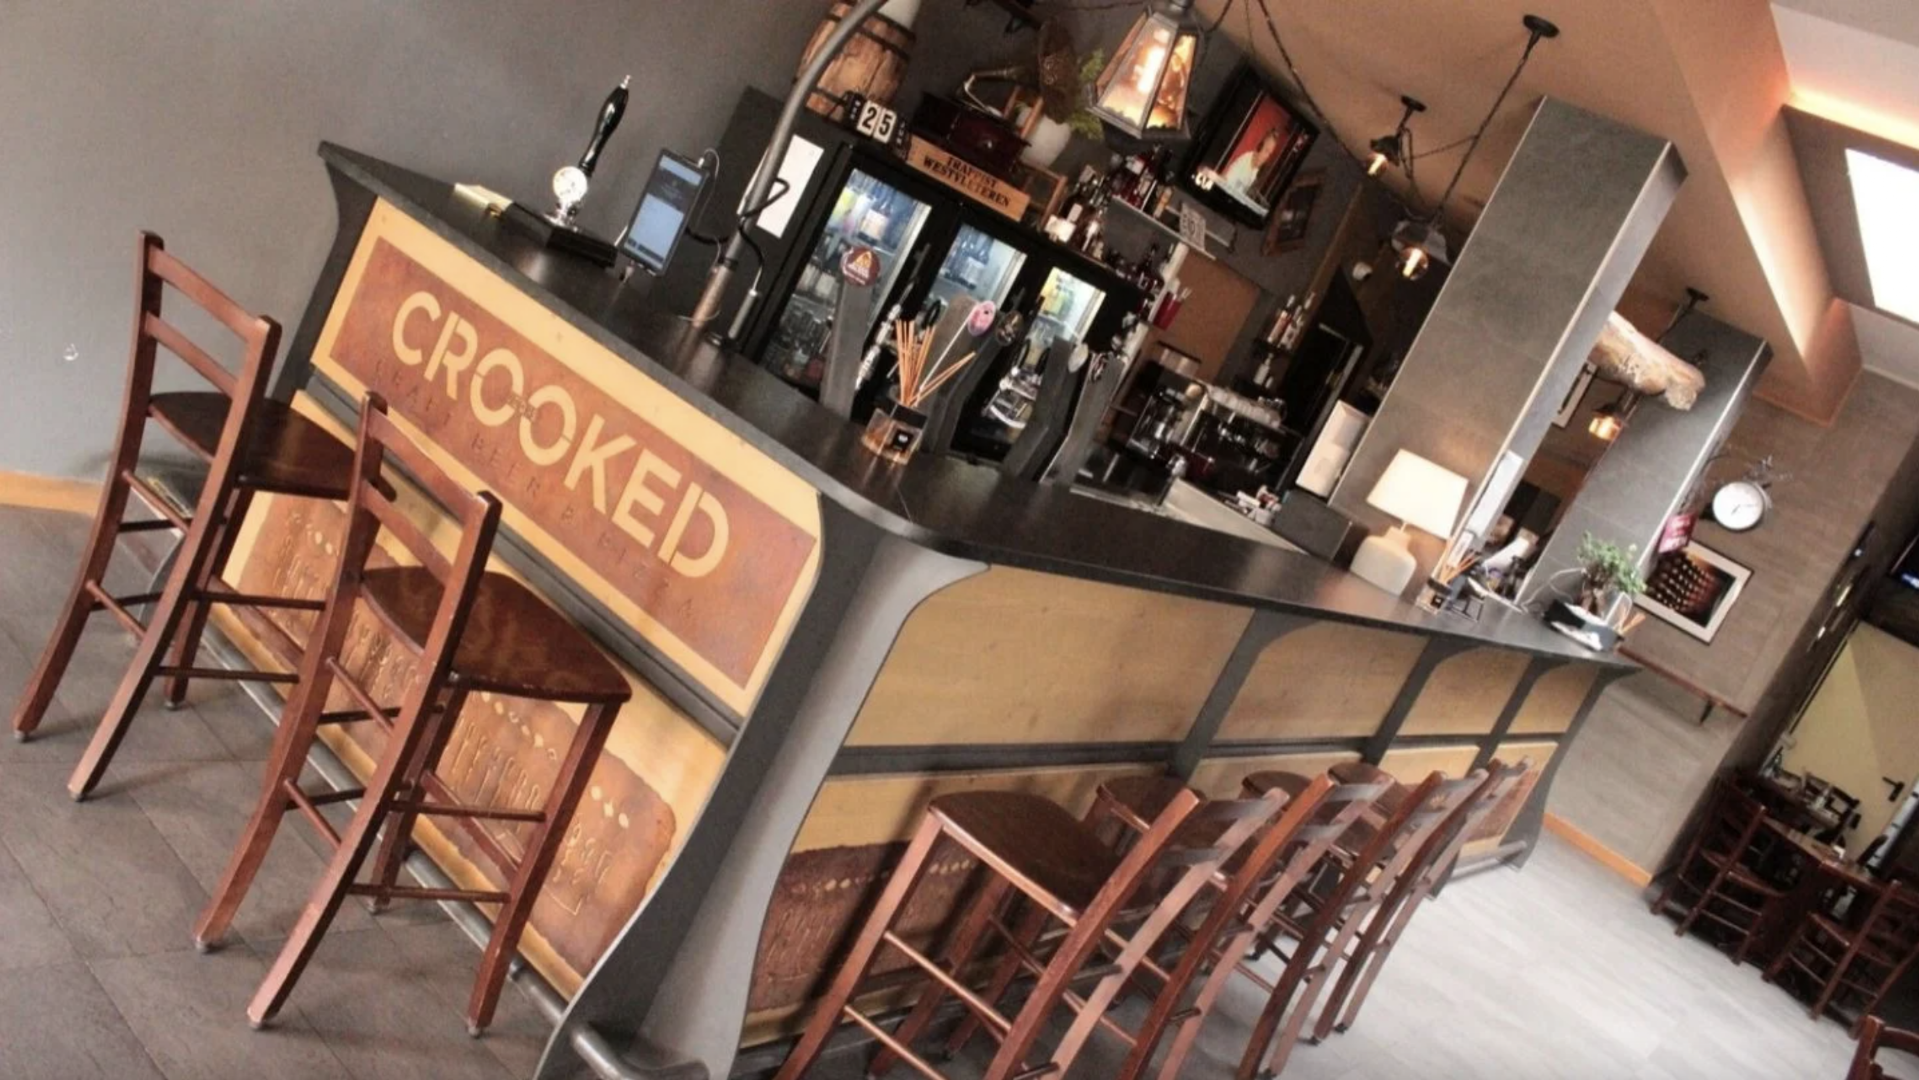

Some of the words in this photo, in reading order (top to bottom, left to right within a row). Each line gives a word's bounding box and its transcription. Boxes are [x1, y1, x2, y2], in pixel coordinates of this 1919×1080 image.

[861, 106, 894, 137] 25
[947, 156, 999, 188] TRAPPIST
[393, 290, 730, 578] CROOKED
[471, 431, 542, 496] BEER
